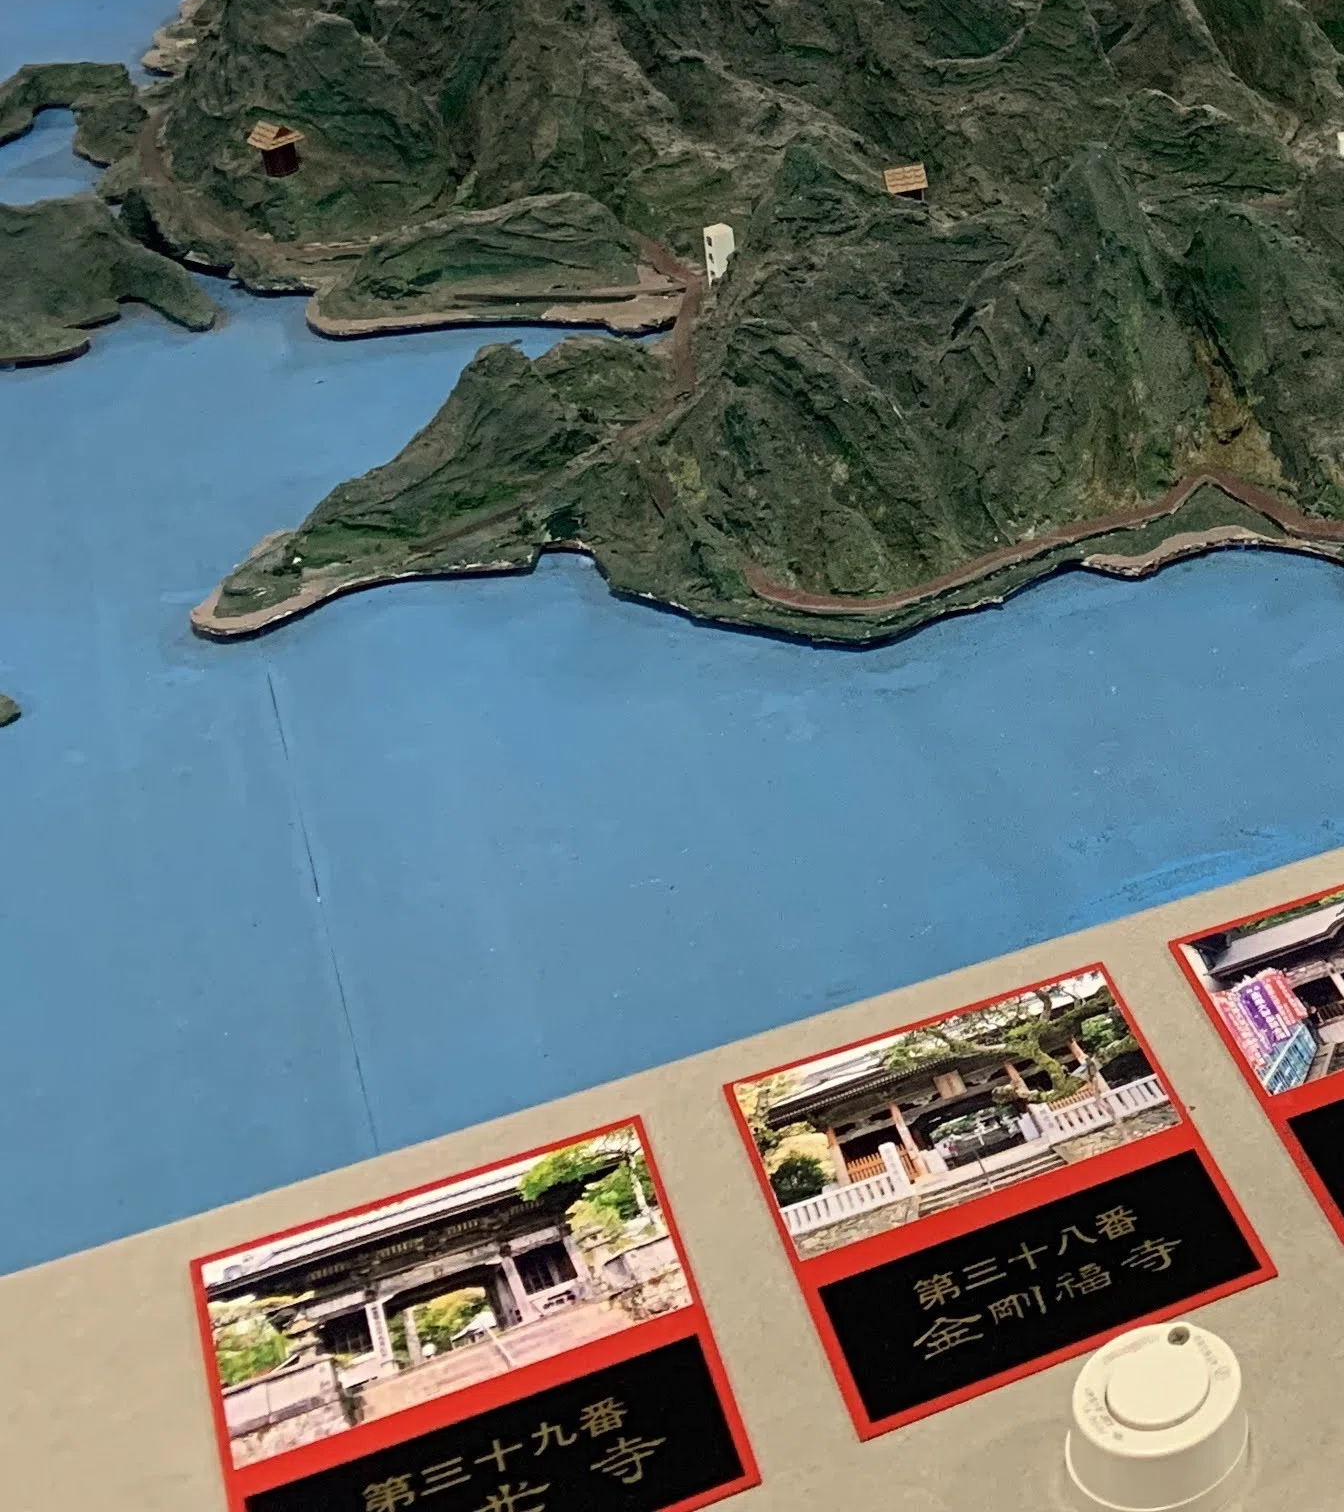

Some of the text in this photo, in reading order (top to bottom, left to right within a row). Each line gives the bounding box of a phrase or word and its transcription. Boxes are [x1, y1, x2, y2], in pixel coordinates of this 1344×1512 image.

[912, 1236, 1183, 1361] 金剛福寺
[913, 1205, 1138, 1310] 第三十八番
[361, 1396, 629, 1512] 第三十九番
